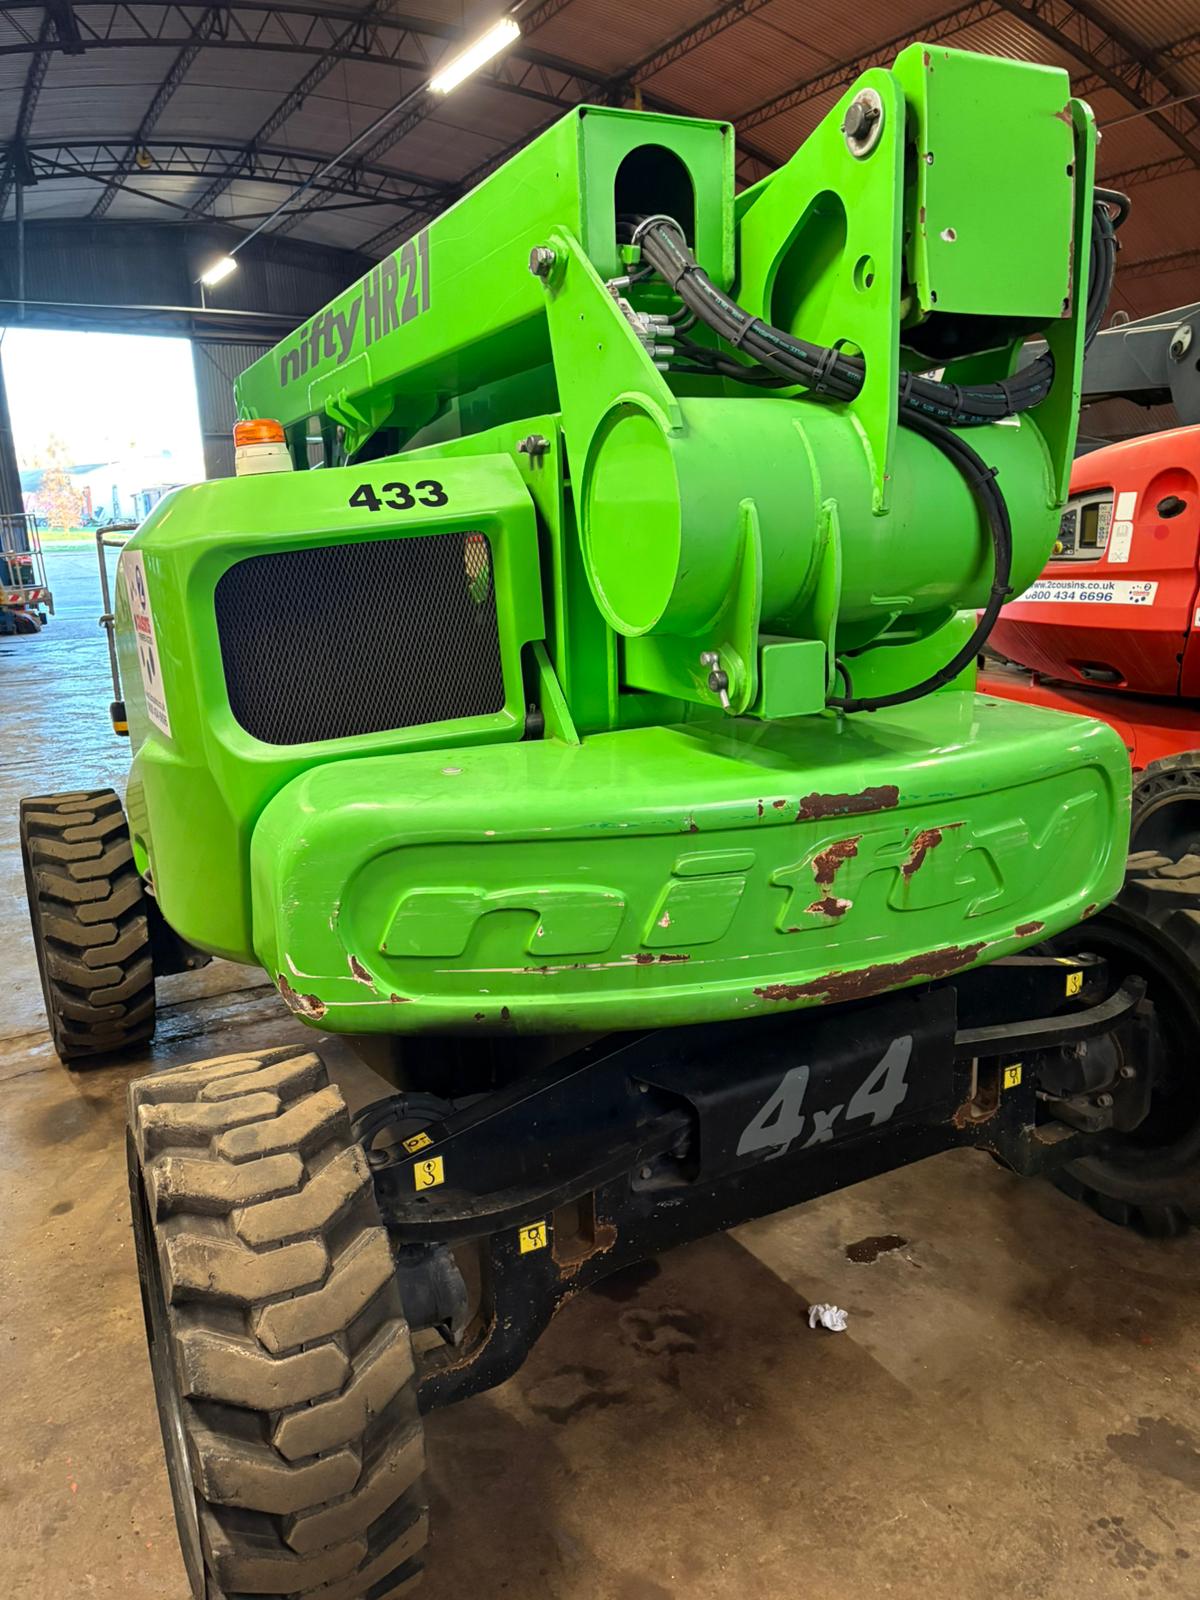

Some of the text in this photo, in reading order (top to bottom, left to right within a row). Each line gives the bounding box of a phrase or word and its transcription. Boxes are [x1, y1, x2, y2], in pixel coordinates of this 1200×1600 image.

[348, 479, 449, 512] 433
[1053, 591, 1075, 601] 434
[1079, 591, 1113, 602] 6696
[380, 790, 1099, 958] nifty
[736, 1035, 912, 1161] 4x4
